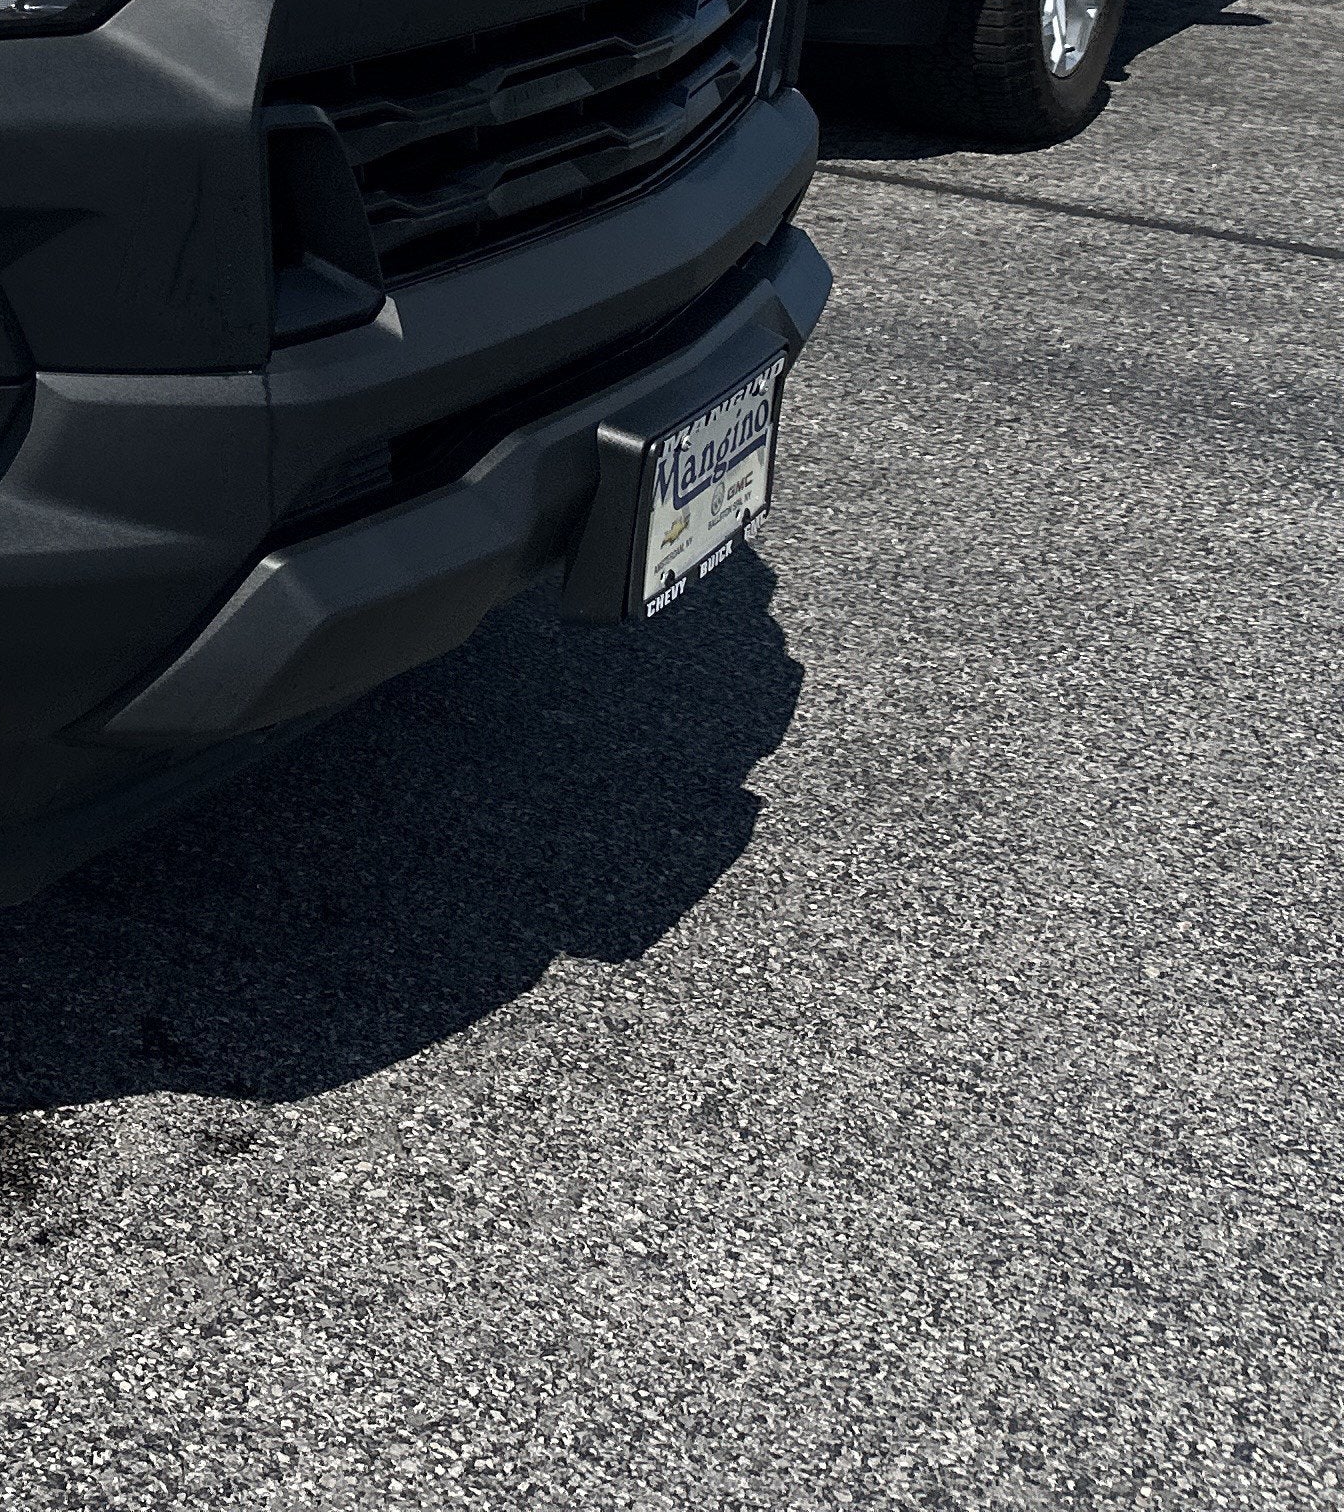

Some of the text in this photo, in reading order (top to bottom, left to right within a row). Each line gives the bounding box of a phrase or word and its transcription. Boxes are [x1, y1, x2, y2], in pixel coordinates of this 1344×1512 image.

[653, 399, 770, 508] Mangino
[727, 470, 754, 501] GMC
[646, 576, 687, 618] CHEVY
[699, 539, 733, 579] BUICK
